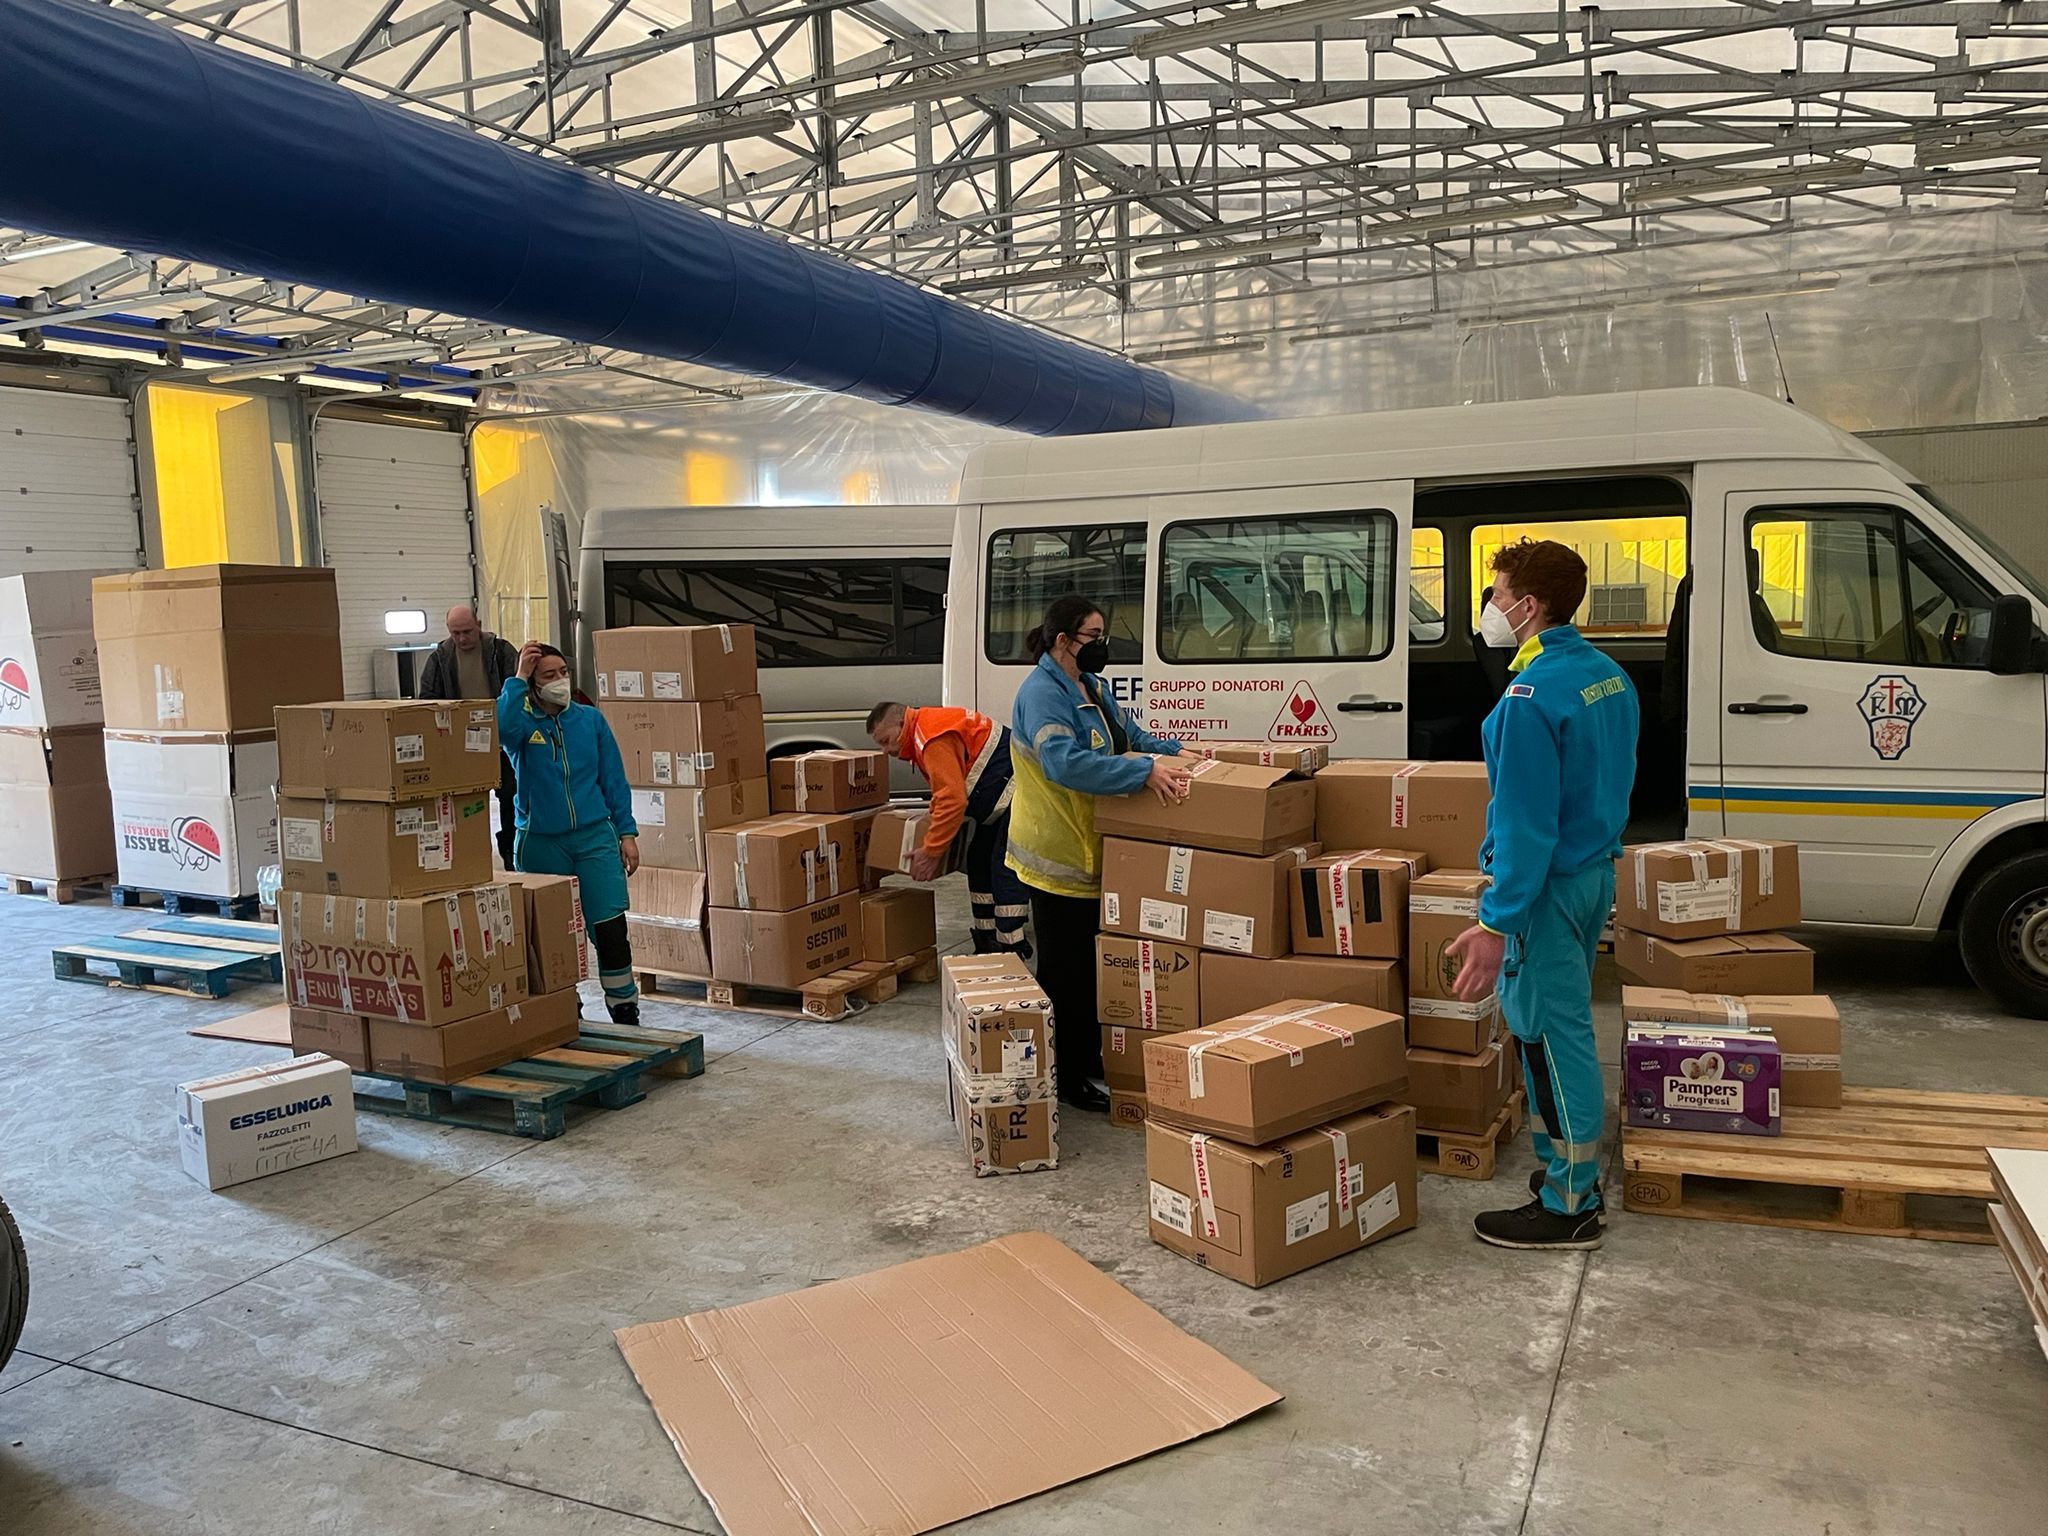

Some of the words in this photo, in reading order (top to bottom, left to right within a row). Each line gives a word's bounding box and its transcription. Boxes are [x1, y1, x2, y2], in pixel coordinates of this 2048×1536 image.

[1149, 680, 1206, 692] GRUPPO
[1211, 679, 1284, 692] DONATORI
[1149, 698, 1206, 711] SANGUE
[1149, 719, 1164, 730] G.
[1168, 719, 1229, 730] MANETTI
[123, 834, 172, 854] BASSI
[1333, 863, 1344, 909] FRAGILE
[573, 898, 584, 933] FRAGILE
[806, 923, 848, 951] SESTINI
[318, 944, 421, 981] TOYOTA
[578, 944, 589, 978] FRAGILE
[1153, 958, 1172, 973] Air
[1311, 1021, 1353, 1044] FRAGILE
[1261, 1038, 1301, 1059] FRAGILE
[1669, 1079, 1738, 1097] Pampers
[1676, 1094, 1730, 1107] Progressi
[229, 1094, 333, 1131] ESSELUNGA
[1120, 1107, 1140, 1119] EPAL
[1662, 1113, 1671, 1124] 5
[256, 1120, 311, 1142] FAZZOLETTI
[1194, 1141, 1209, 1199] FRAGILE
[1338, 1157, 1350, 1212] FRAGILE
[1636, 1186, 1663, 1200] EPAL
